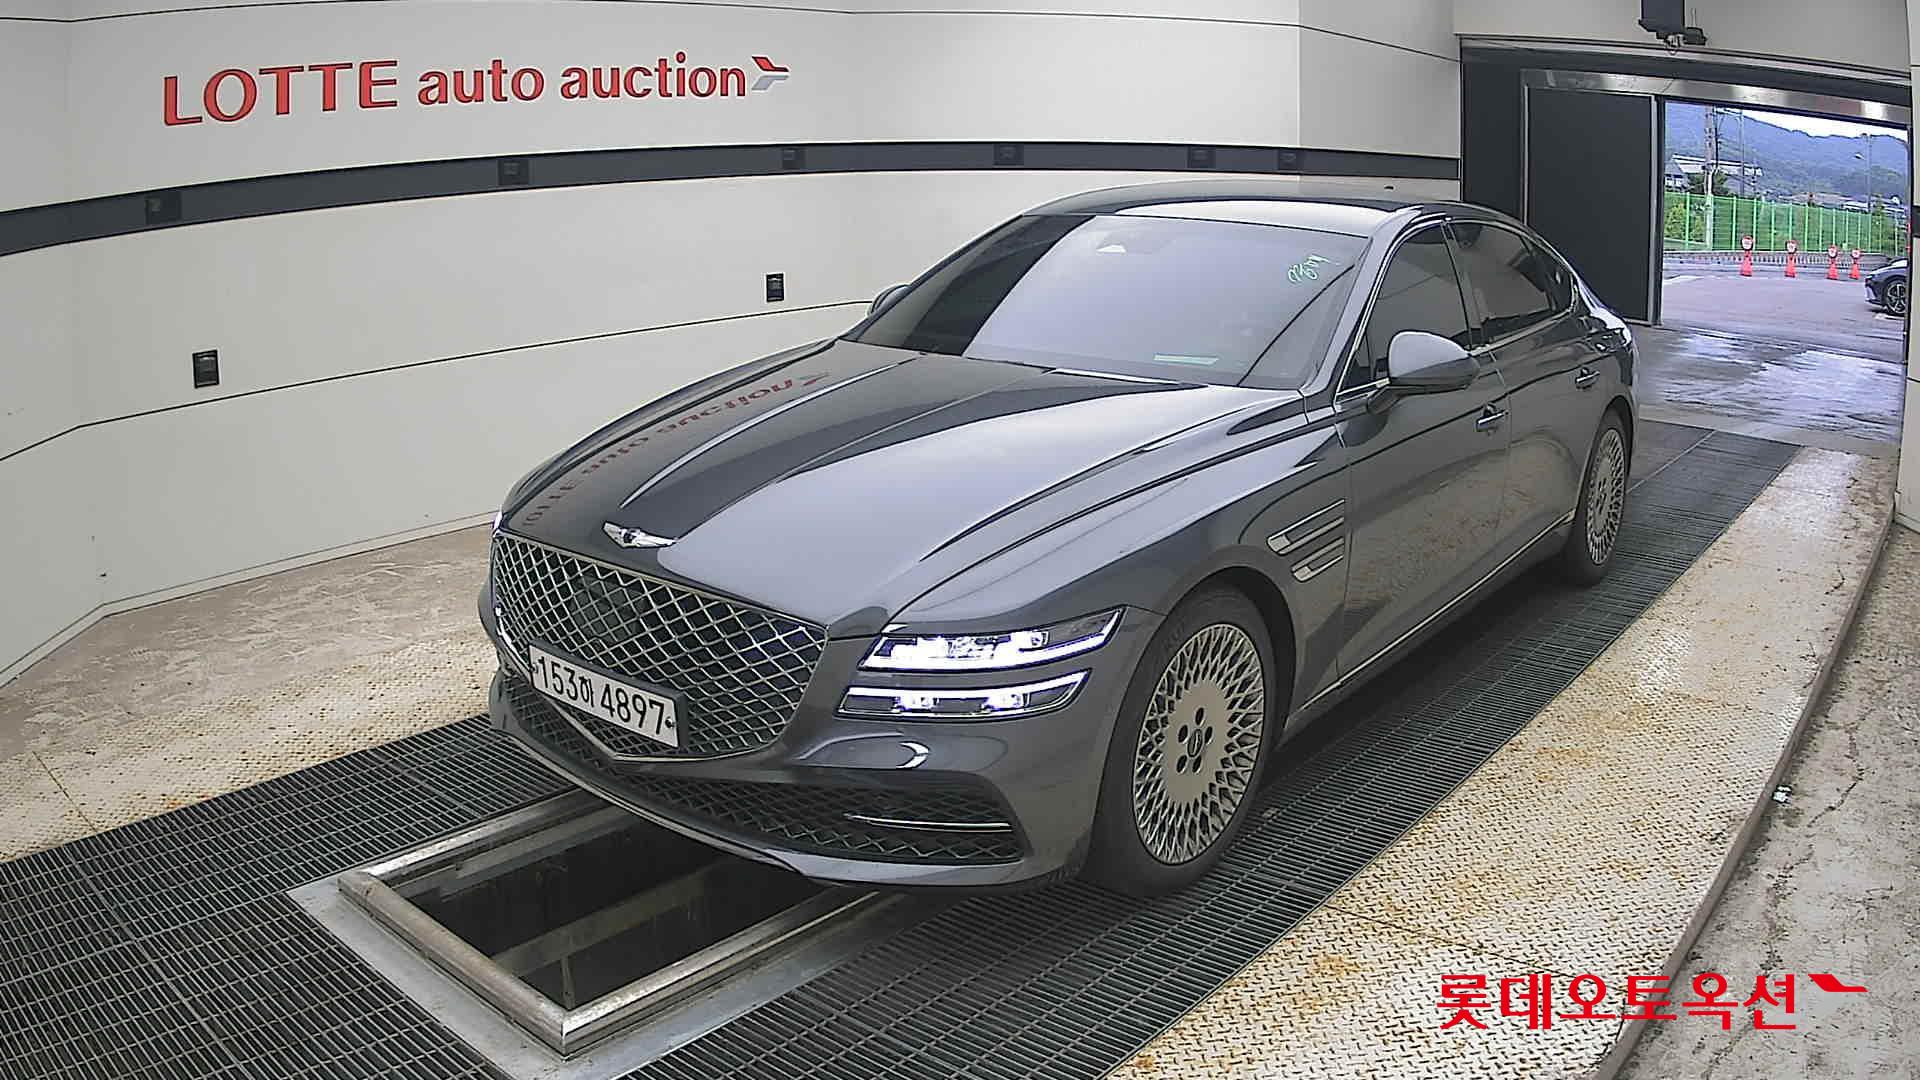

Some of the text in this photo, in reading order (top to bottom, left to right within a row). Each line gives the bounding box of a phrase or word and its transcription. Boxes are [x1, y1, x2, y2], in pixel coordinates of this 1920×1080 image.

[164, 51, 746, 127] LOTTE auto auction
[601, 683, 665, 735] 4897
